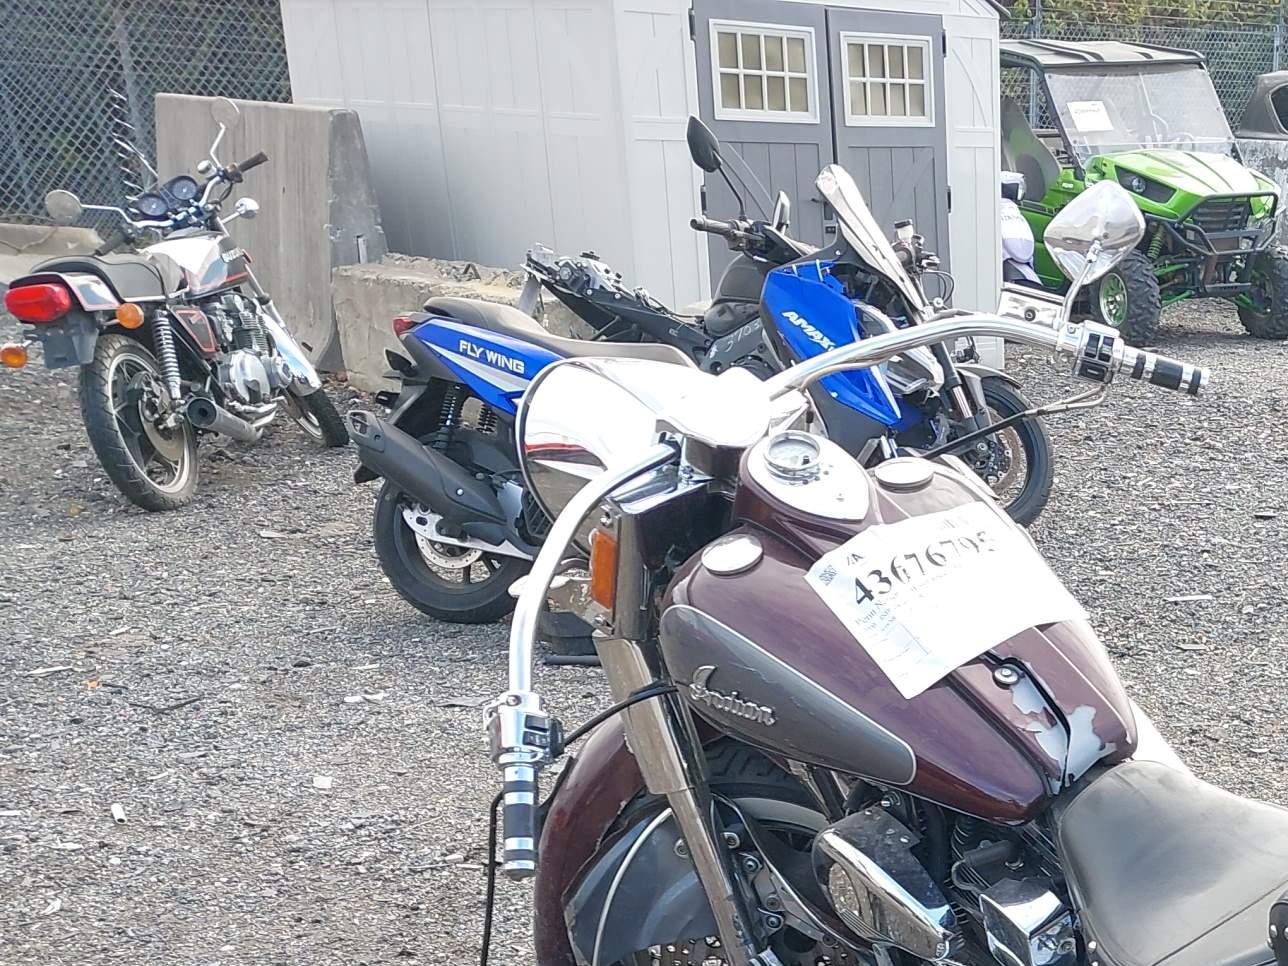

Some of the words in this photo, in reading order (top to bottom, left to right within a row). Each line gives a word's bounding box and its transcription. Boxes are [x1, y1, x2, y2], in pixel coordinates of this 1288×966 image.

[459, 340, 484, 358] FLY
[486, 349, 525, 374] WING
[854, 530, 996, 605] 43676795
[690, 665, 776, 726] Indian
